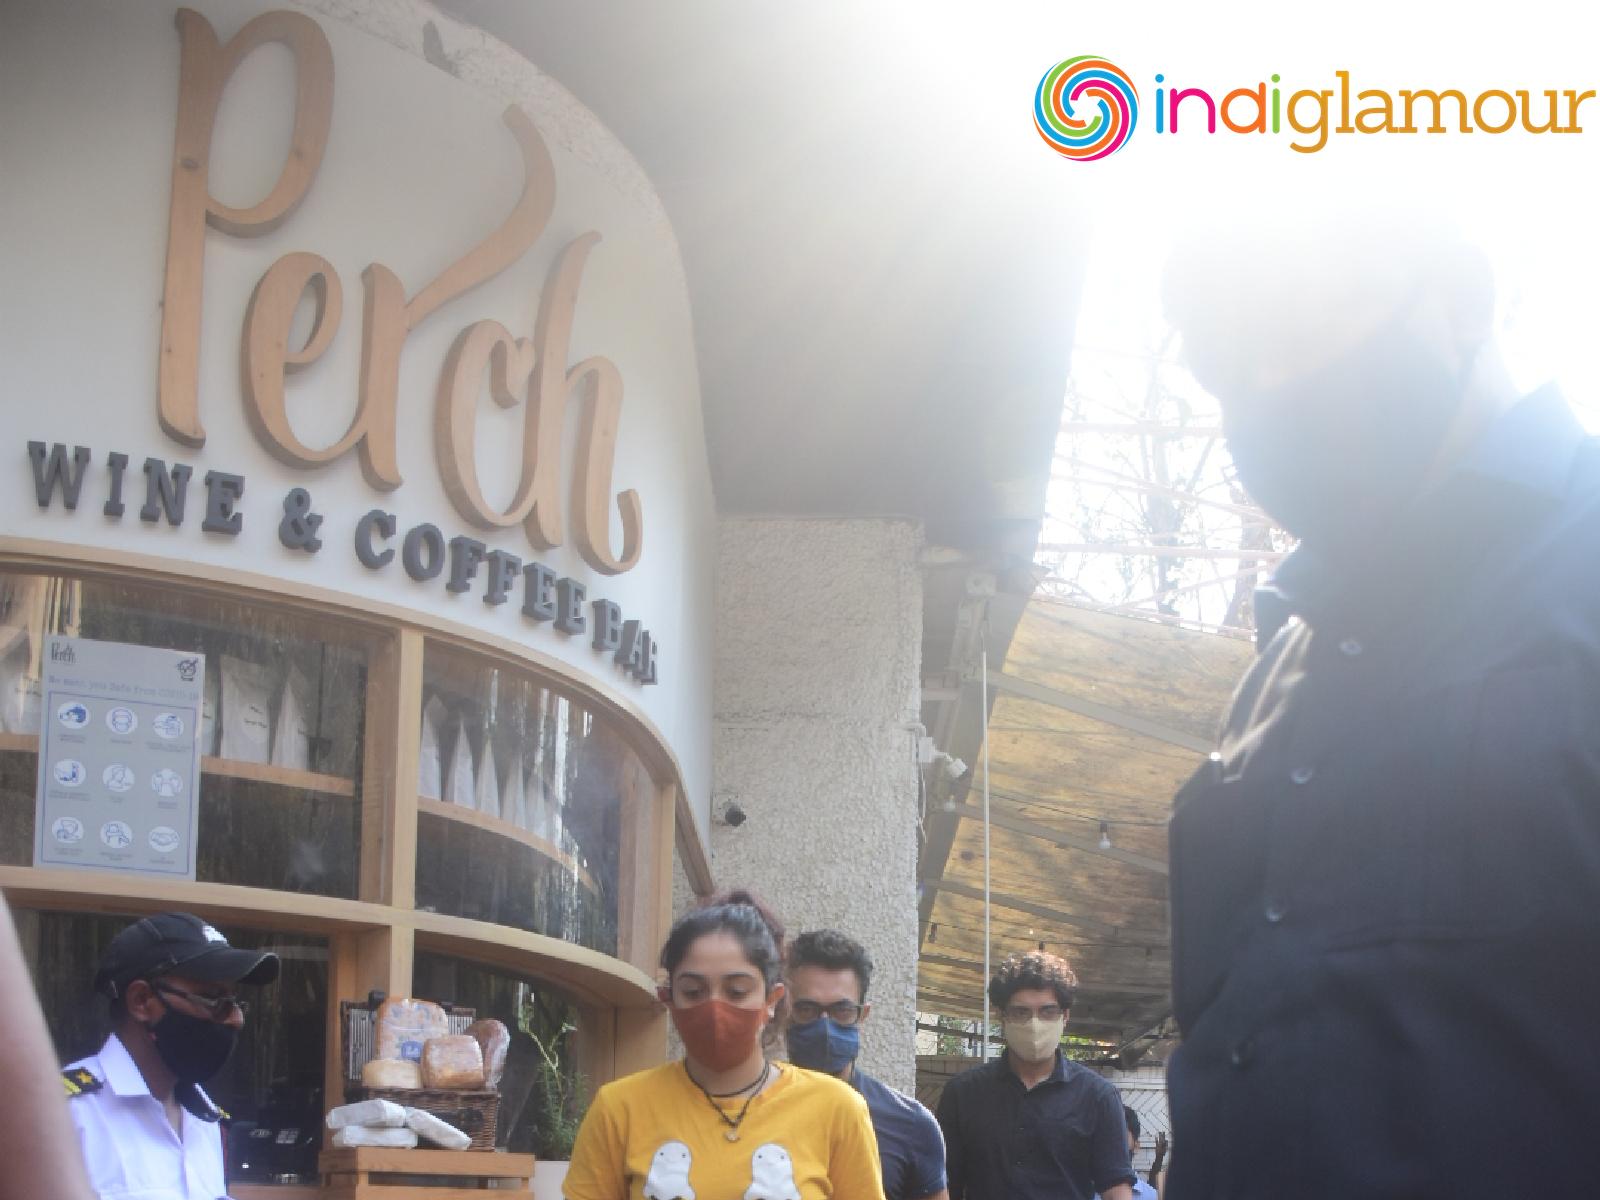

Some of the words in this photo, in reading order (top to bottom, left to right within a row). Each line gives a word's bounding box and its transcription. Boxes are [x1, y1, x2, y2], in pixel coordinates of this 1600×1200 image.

[157, 7, 643, 577] Perch
[27, 440, 245, 536] WINE
[278, 488, 323, 552] &
[354, 509, 588, 637] COFFEE
